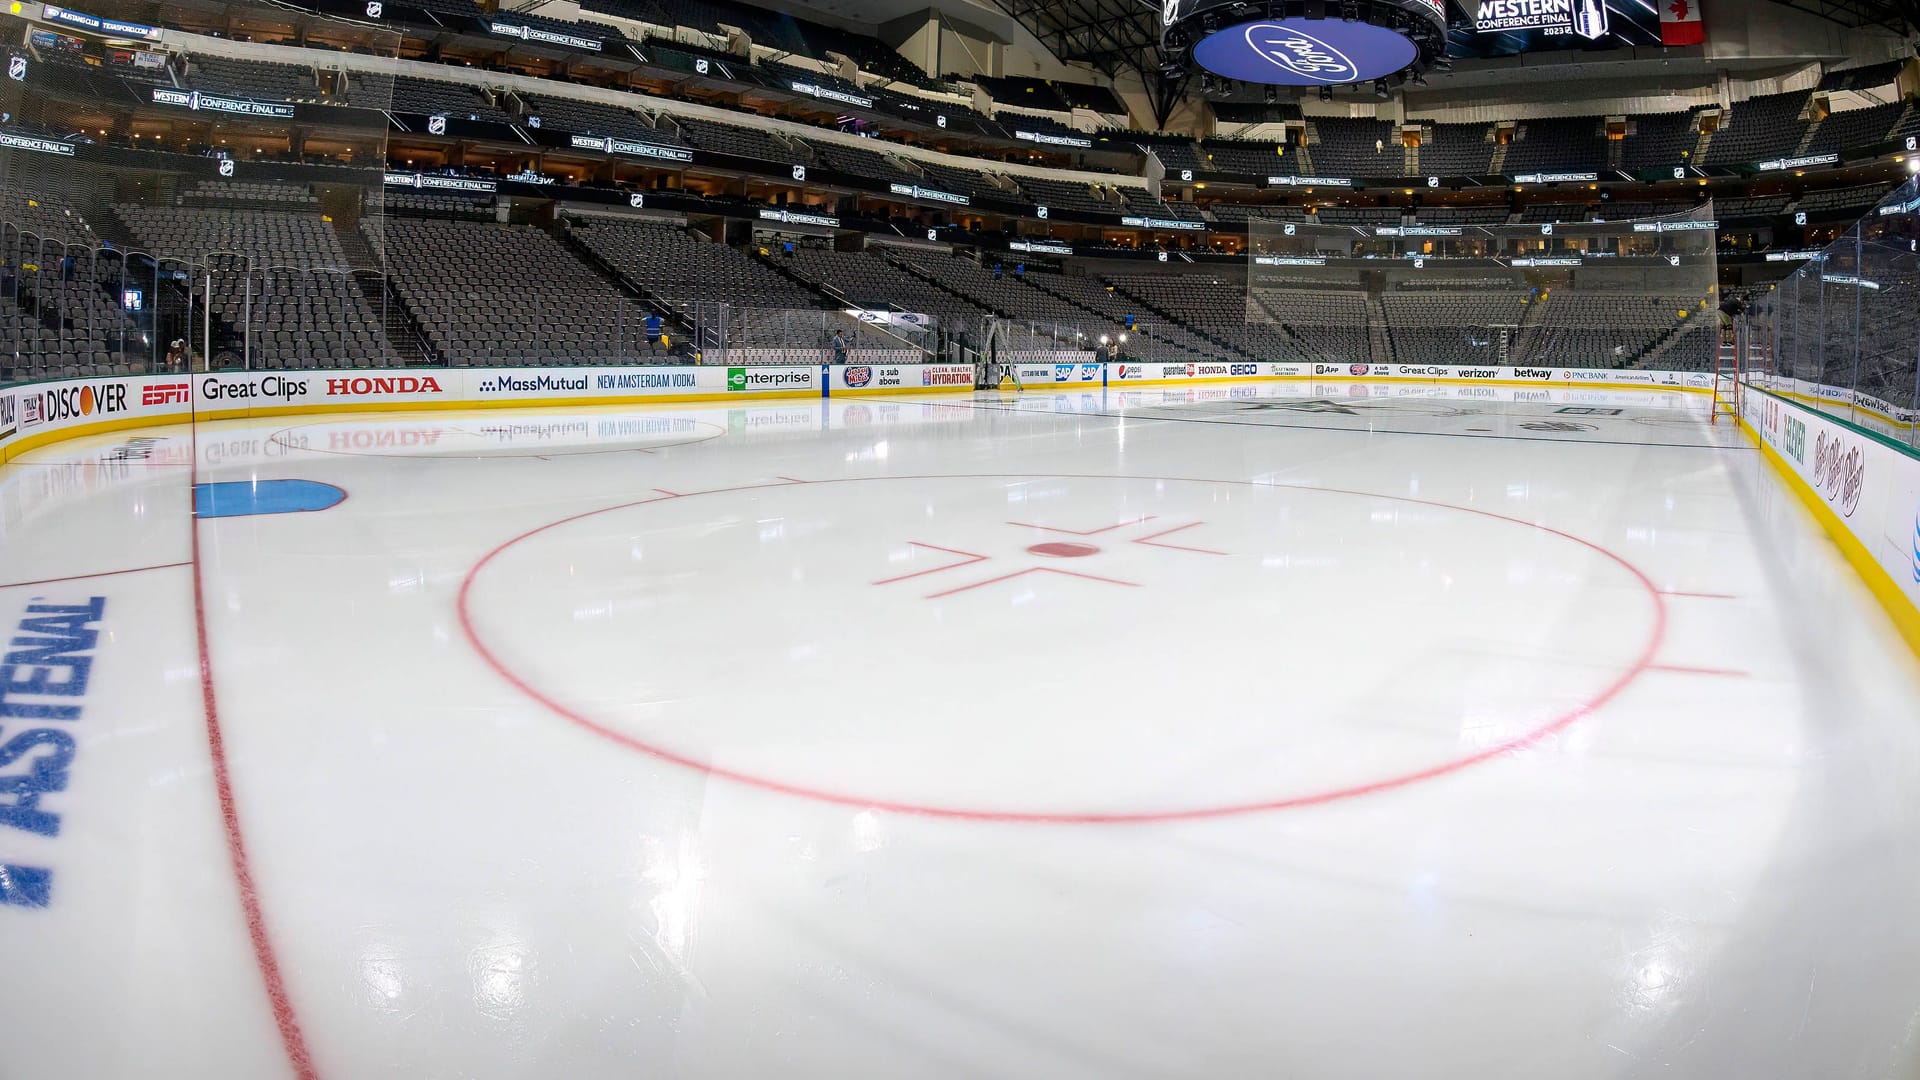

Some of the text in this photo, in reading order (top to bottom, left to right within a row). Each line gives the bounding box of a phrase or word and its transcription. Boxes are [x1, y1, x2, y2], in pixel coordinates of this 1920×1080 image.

[1477, 0, 1570, 20] WESTERN
[60, 12, 86, 25] MUSTANG
[86, 17, 99, 27] CLUB
[1476, 13, 1571, 30] CONFERENCE FINAL
[491, 22, 521, 37] WESTERN
[529, 31, 569, 44] CONFERENCE
[569, 37, 588, 48] FINAL
[1543, 27, 1564, 36] 2023
[792, 82, 814, 94] WESTERN
[153, 90, 190, 104] WESTERN
[200, 96, 251, 112] CONFERENCE
[251, 103, 275, 114] FINAL
[1, 137, 41, 150] CONFERENCE
[41, 142, 60, 152] FINAL
[572, 137, 604, 149] WESTERN
[614, 143, 658, 157] CONFERENCE
[658, 149, 677, 159] FINAL
[384, 175, 413, 185] WESTERN
[422, 178, 464, 190] CONFERENCE
[464, 181, 482, 191] FINAL
[891, 184, 912, 194] WESTERN
[760, 210, 830, 226] WESTERN CONFERENCE FINAL
[848, 366, 868, 376] Jersey
[886, 367, 899, 376] sub
[1000, 366, 1017, 384] CA
[1056, 367, 1071, 379] SAP
[1082, 367, 1096, 379] SAP
[1198, 365, 1228, 375] HONDA
[1231, 364, 1257, 375] GEICO
[1399, 365, 1448, 377] Great Clips
[1458, 368, 1496, 379] verizon
[1514, 368, 1552, 380] betway
[1572, 372, 1608, 380] PNC BANK
[326, 377, 443, 396] HONDA
[499, 375, 588, 392] MassMutual
[597, 373, 696, 389] NEW AMSTERDAM VODKA
[733, 371, 810, 387] enterprise
[878, 376, 901, 386] above
[142, 383, 189, 406] ESPN
[202, 376, 307, 401] Great Clips
[24, 397, 38, 412] TRULY
[47, 384, 127, 422] DISCOVER
[0, 597, 106, 909] ASTENAL
